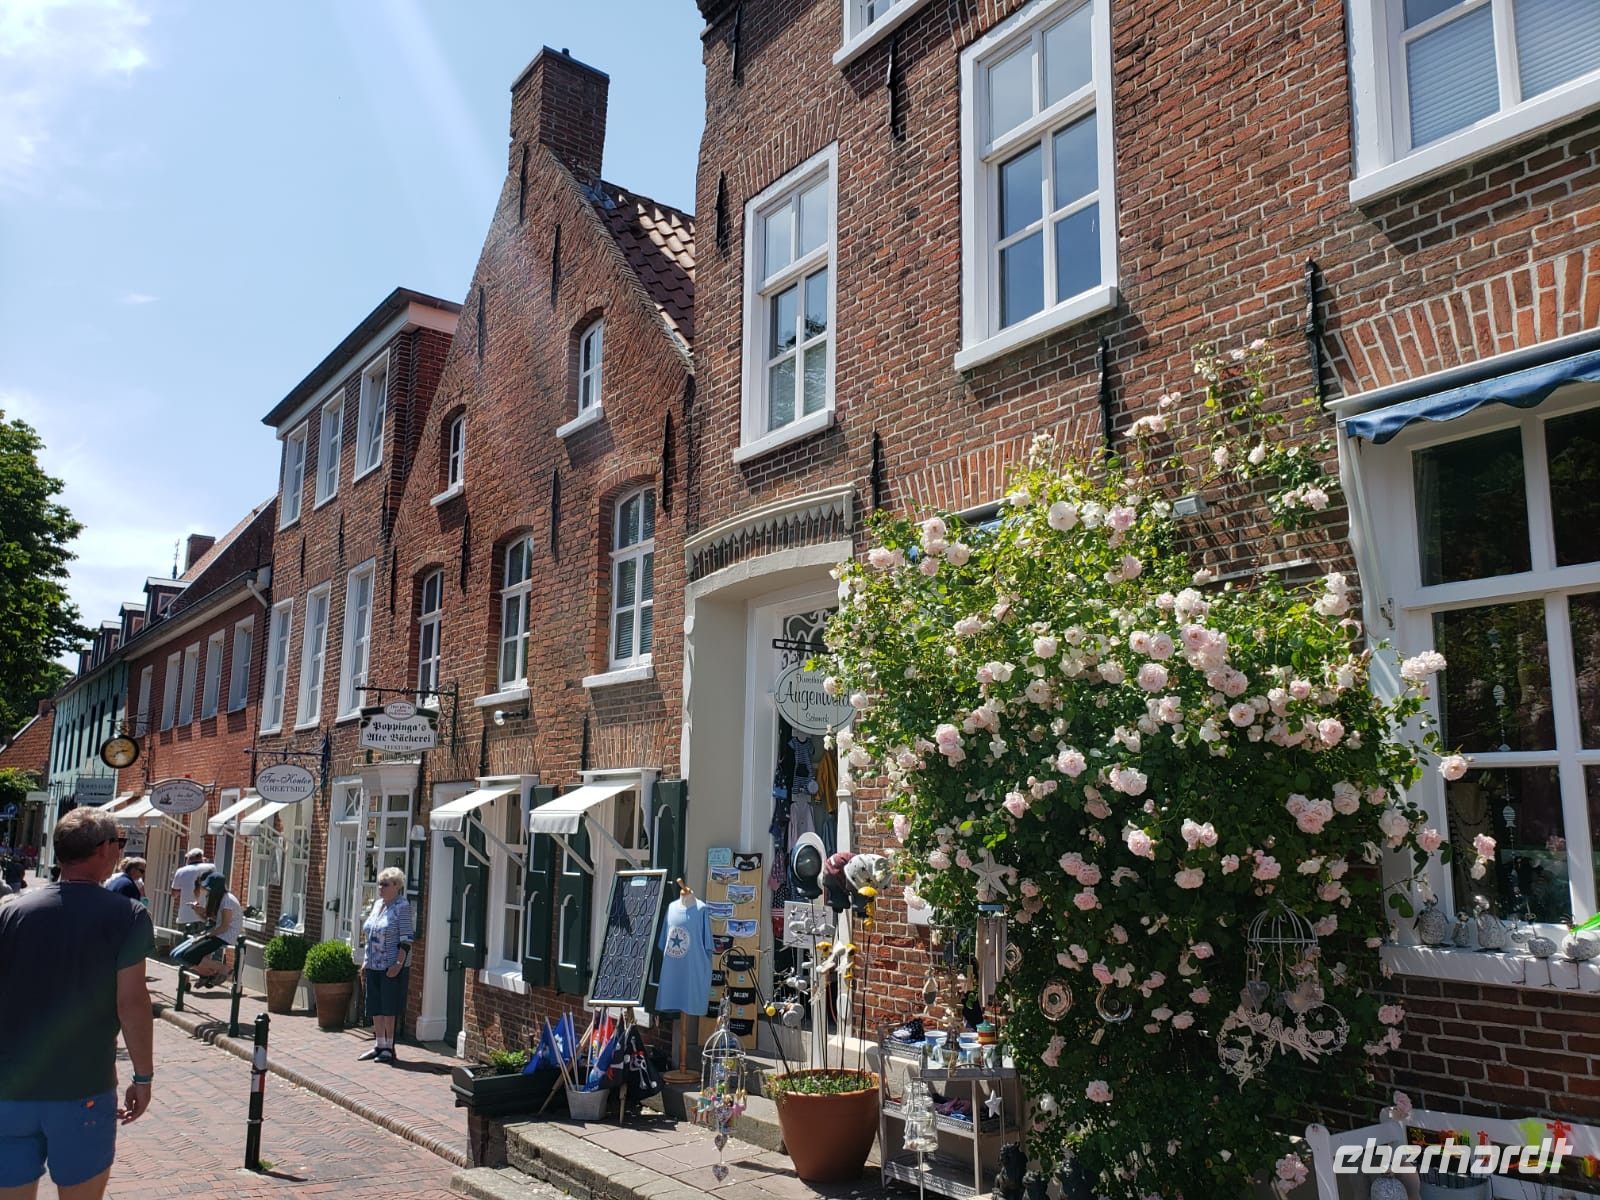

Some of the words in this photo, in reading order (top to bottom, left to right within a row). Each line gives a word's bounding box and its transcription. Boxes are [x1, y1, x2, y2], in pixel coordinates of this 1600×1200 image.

[783, 681, 852, 710] Augenweid
[372, 721, 427, 734] Poppinga's
[366, 732, 387, 742] Alte
[390, 733, 431, 743] Bäckerei
[263, 785, 308, 793] GREETSIEL
